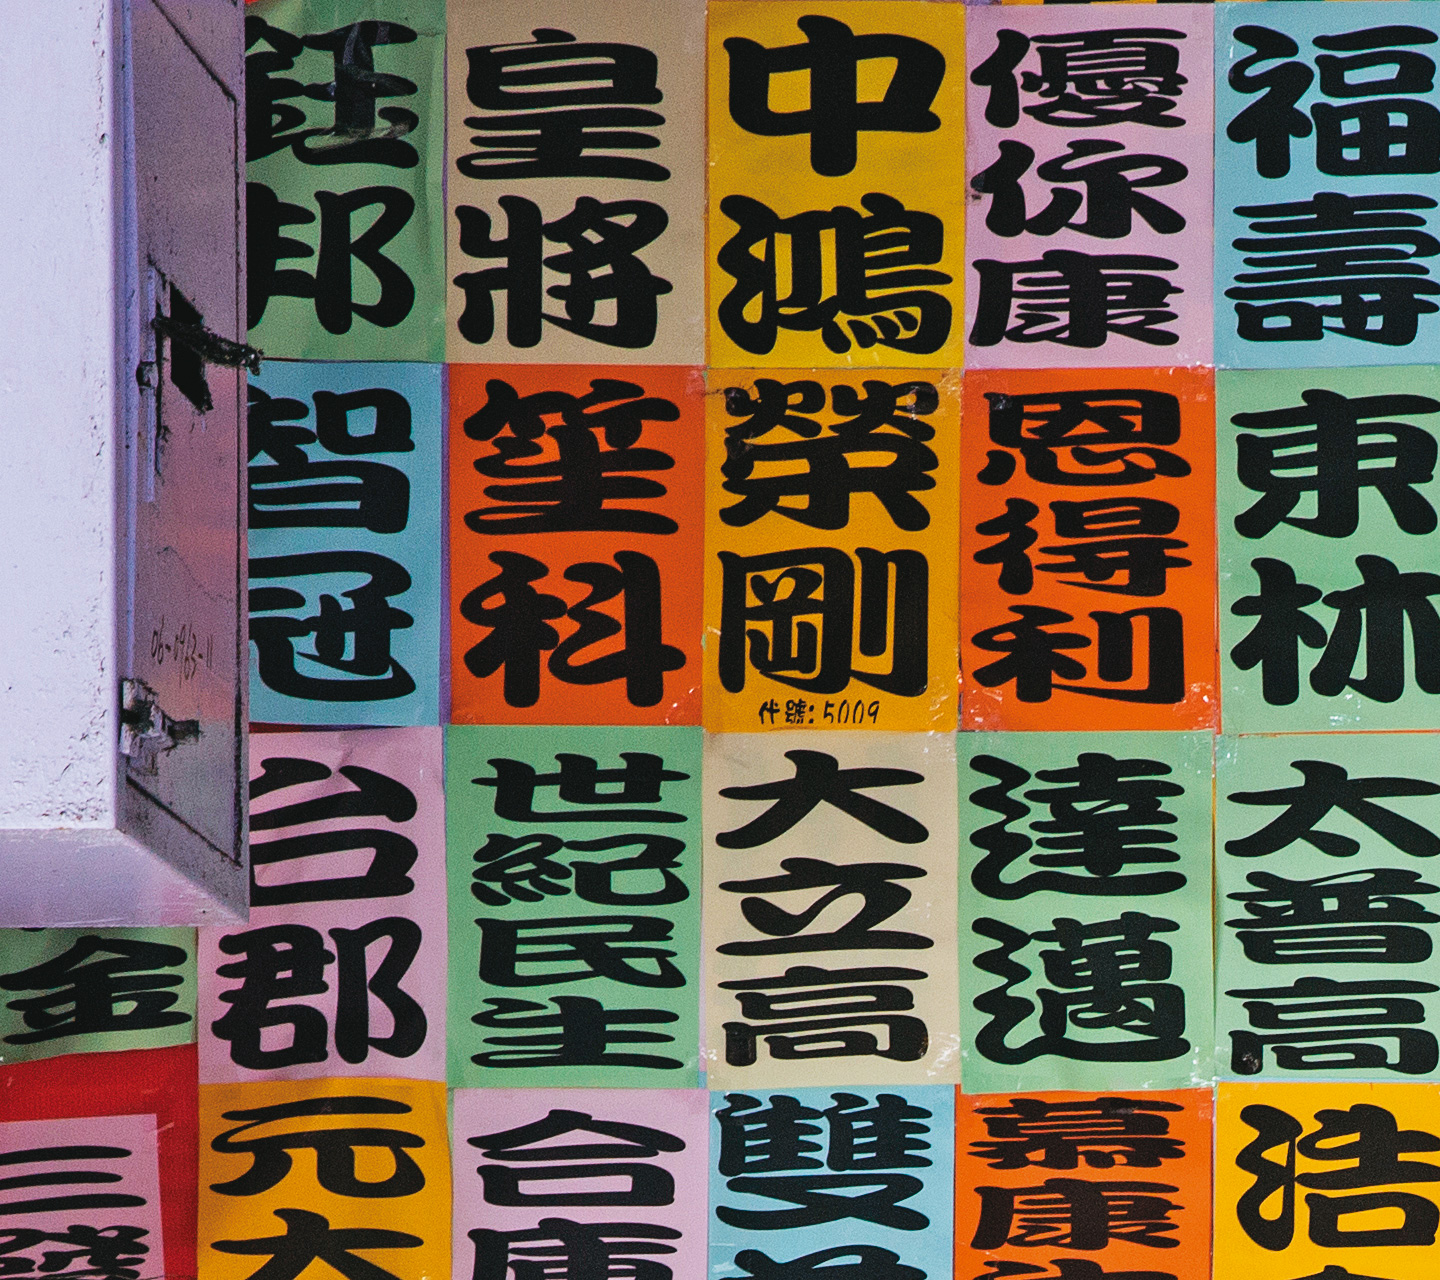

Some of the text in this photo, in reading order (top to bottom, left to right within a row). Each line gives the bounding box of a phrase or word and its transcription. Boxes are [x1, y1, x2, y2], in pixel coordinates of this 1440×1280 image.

[453, 28, 673, 348] 皇將
[718, 15, 952, 354] 中鴻
[969, 29, 1188, 348] 優你康
[718, 379, 939, 695] 榮剛
[972, 389, 1191, 704] 恩得利
[211, 757, 427, 1070] 台郡
[471, 752, 690, 1069] 世紀民生
[716, 750, 934, 1066] 大立高
[969, 753, 1190, 1065] 達邁
